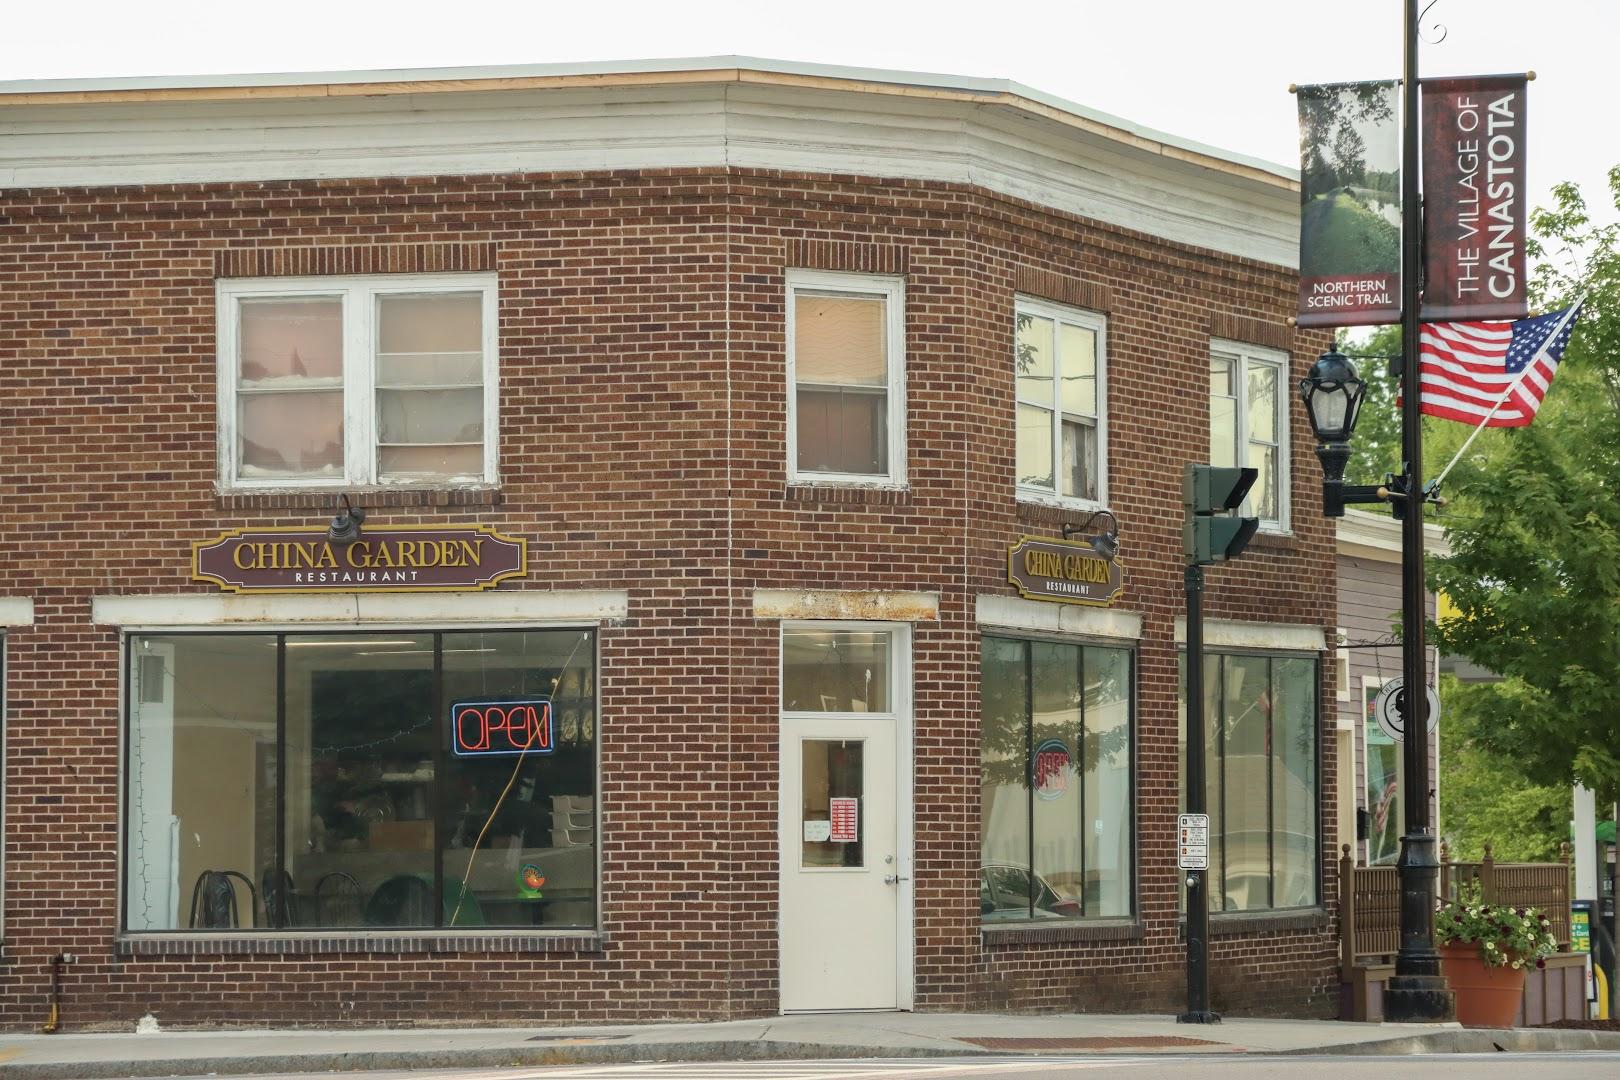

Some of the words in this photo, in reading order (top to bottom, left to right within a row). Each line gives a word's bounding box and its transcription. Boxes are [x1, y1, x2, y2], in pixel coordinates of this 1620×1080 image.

[1457, 96, 1479, 133] OF
[1457, 139, 1479, 241] VILLAGE
[1487, 93, 1515, 299] CANASTOTA
[1313, 279, 1386, 294] NORTHERN
[1458, 247, 1479, 299] THE
[1307, 294, 1354, 308] SCENIC
[1355, 292, 1392, 306] TRAIL
[232, 540, 339, 570] CHINA
[346, 538, 483, 569] GARDEN
[1025, 550, 1063, 578] CHINA
[1064, 555, 1111, 585] GARDEN
[295, 570, 419, 583] RESTAURANT
[1046, 581, 1090, 595] RESTAURANT
[457, 704, 550, 750] OPEN
